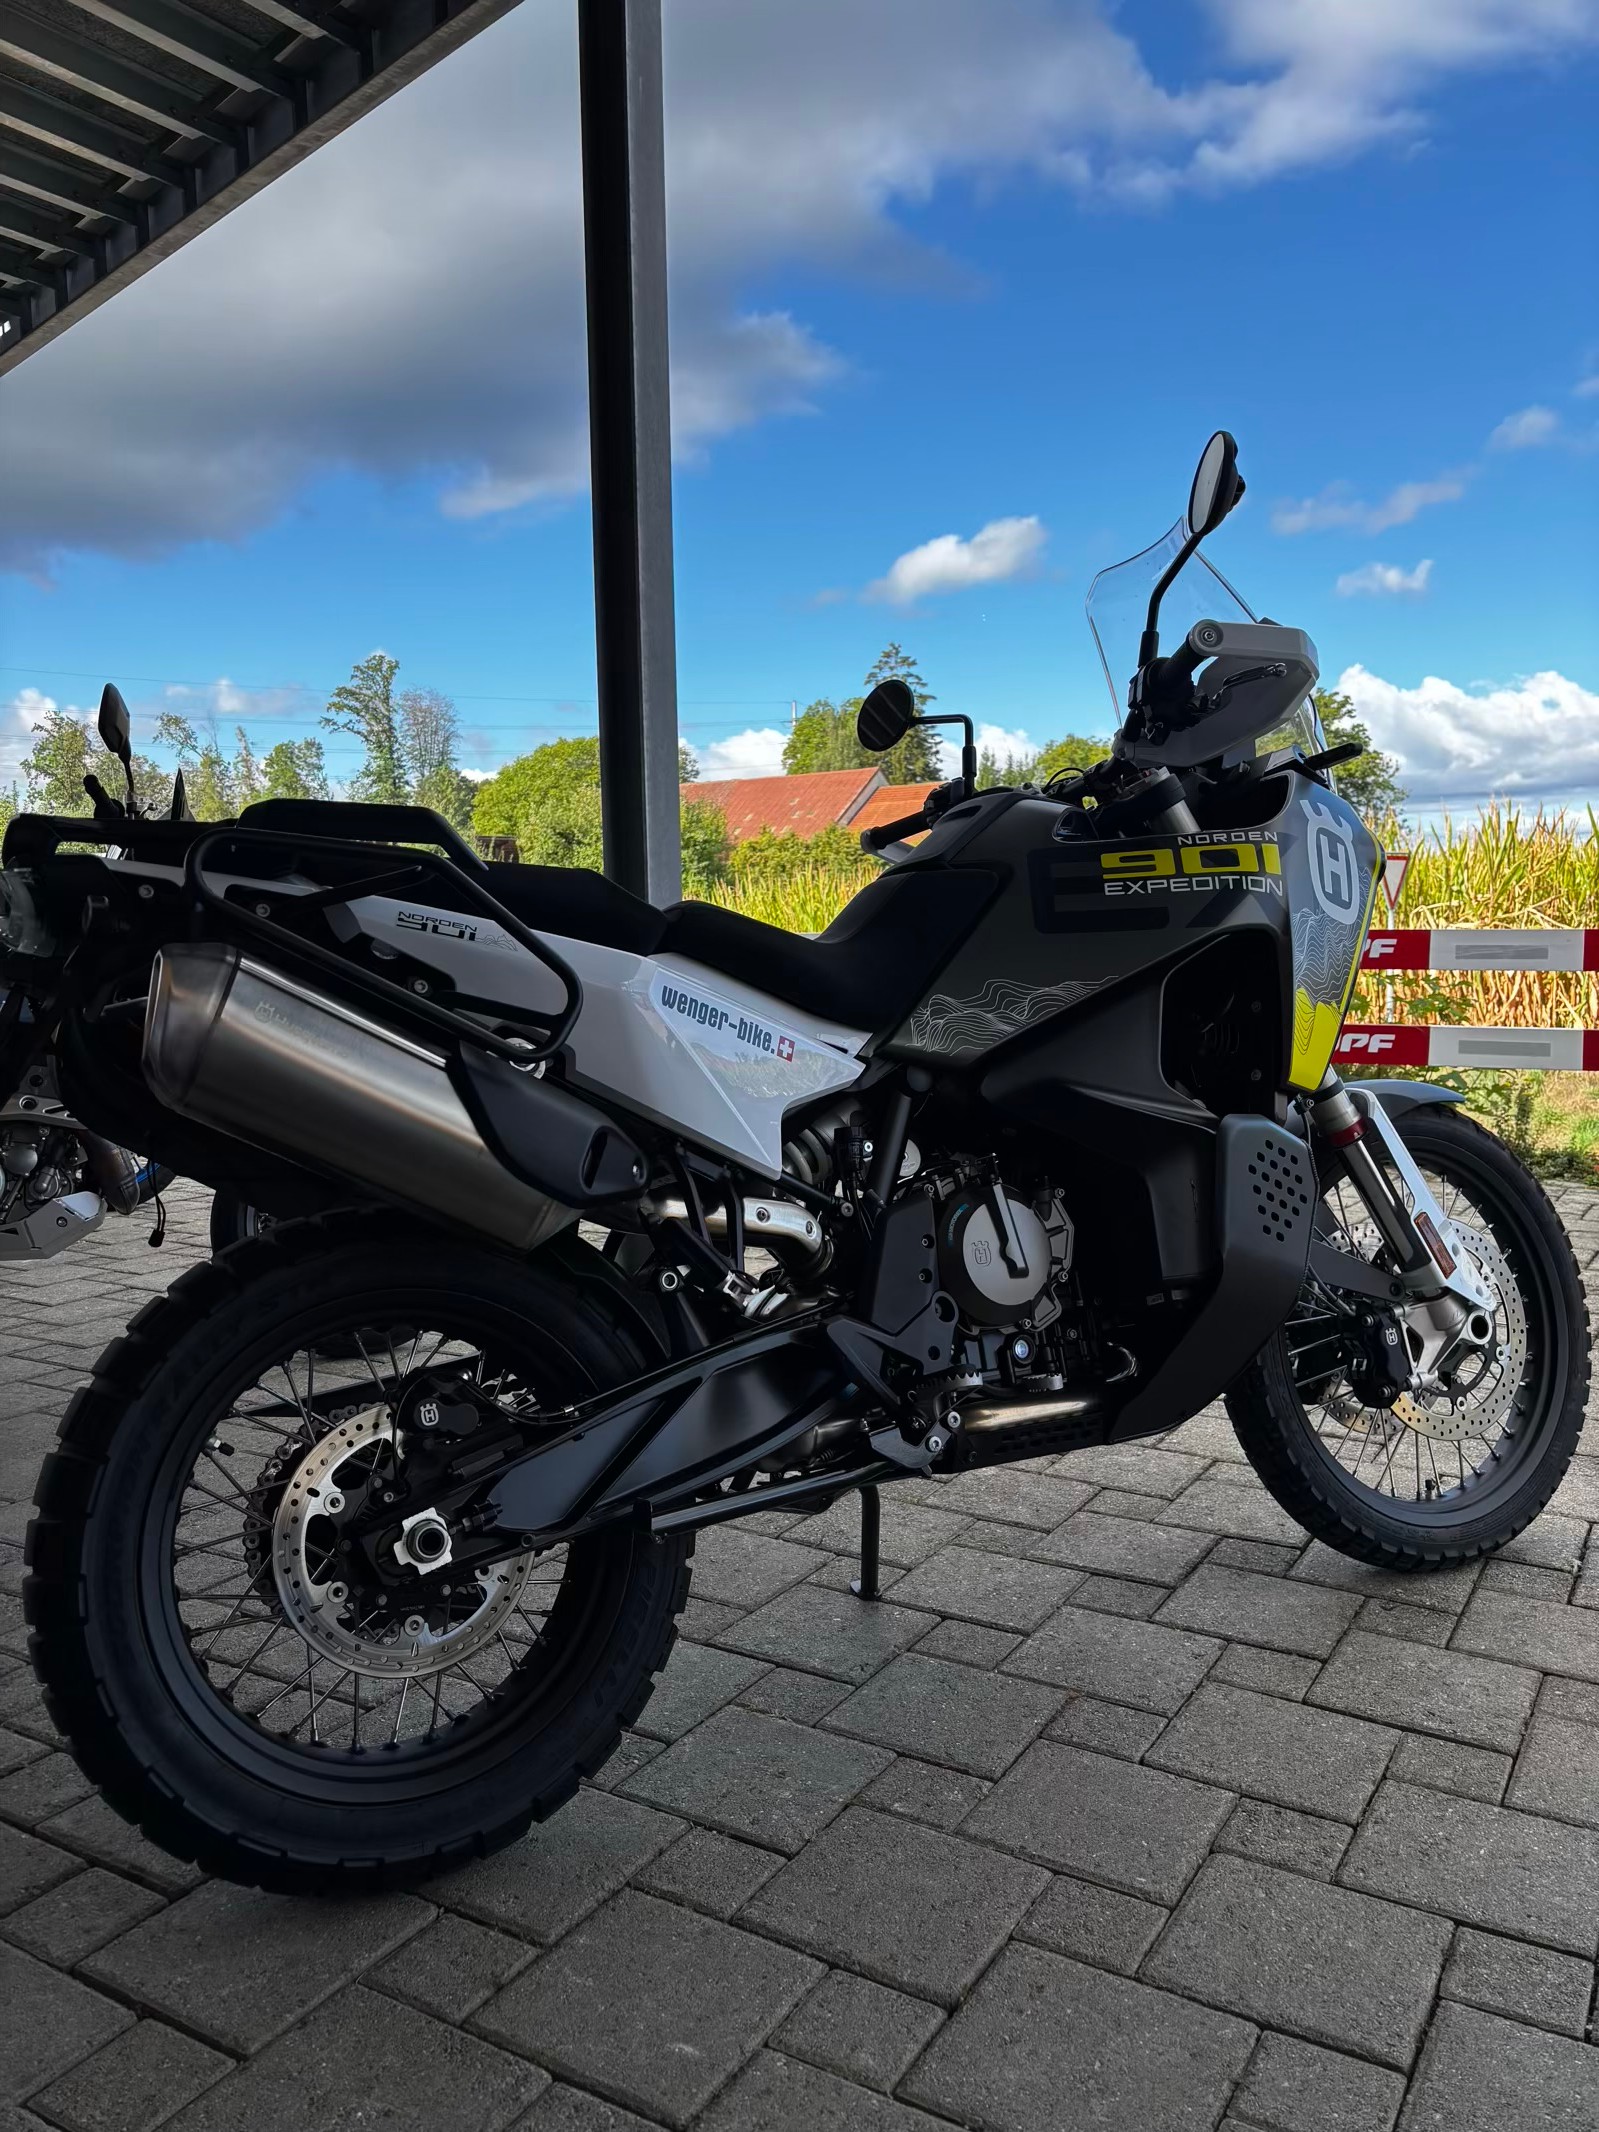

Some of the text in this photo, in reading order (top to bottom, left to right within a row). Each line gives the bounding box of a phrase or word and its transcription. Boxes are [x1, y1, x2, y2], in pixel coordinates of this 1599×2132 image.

[1177, 831, 1278, 846] NORDEN
[1100, 843, 1282, 879] 901
[1104, 875, 1283, 897] EXPEDITION
[397, 911, 478, 933] NORDEN
